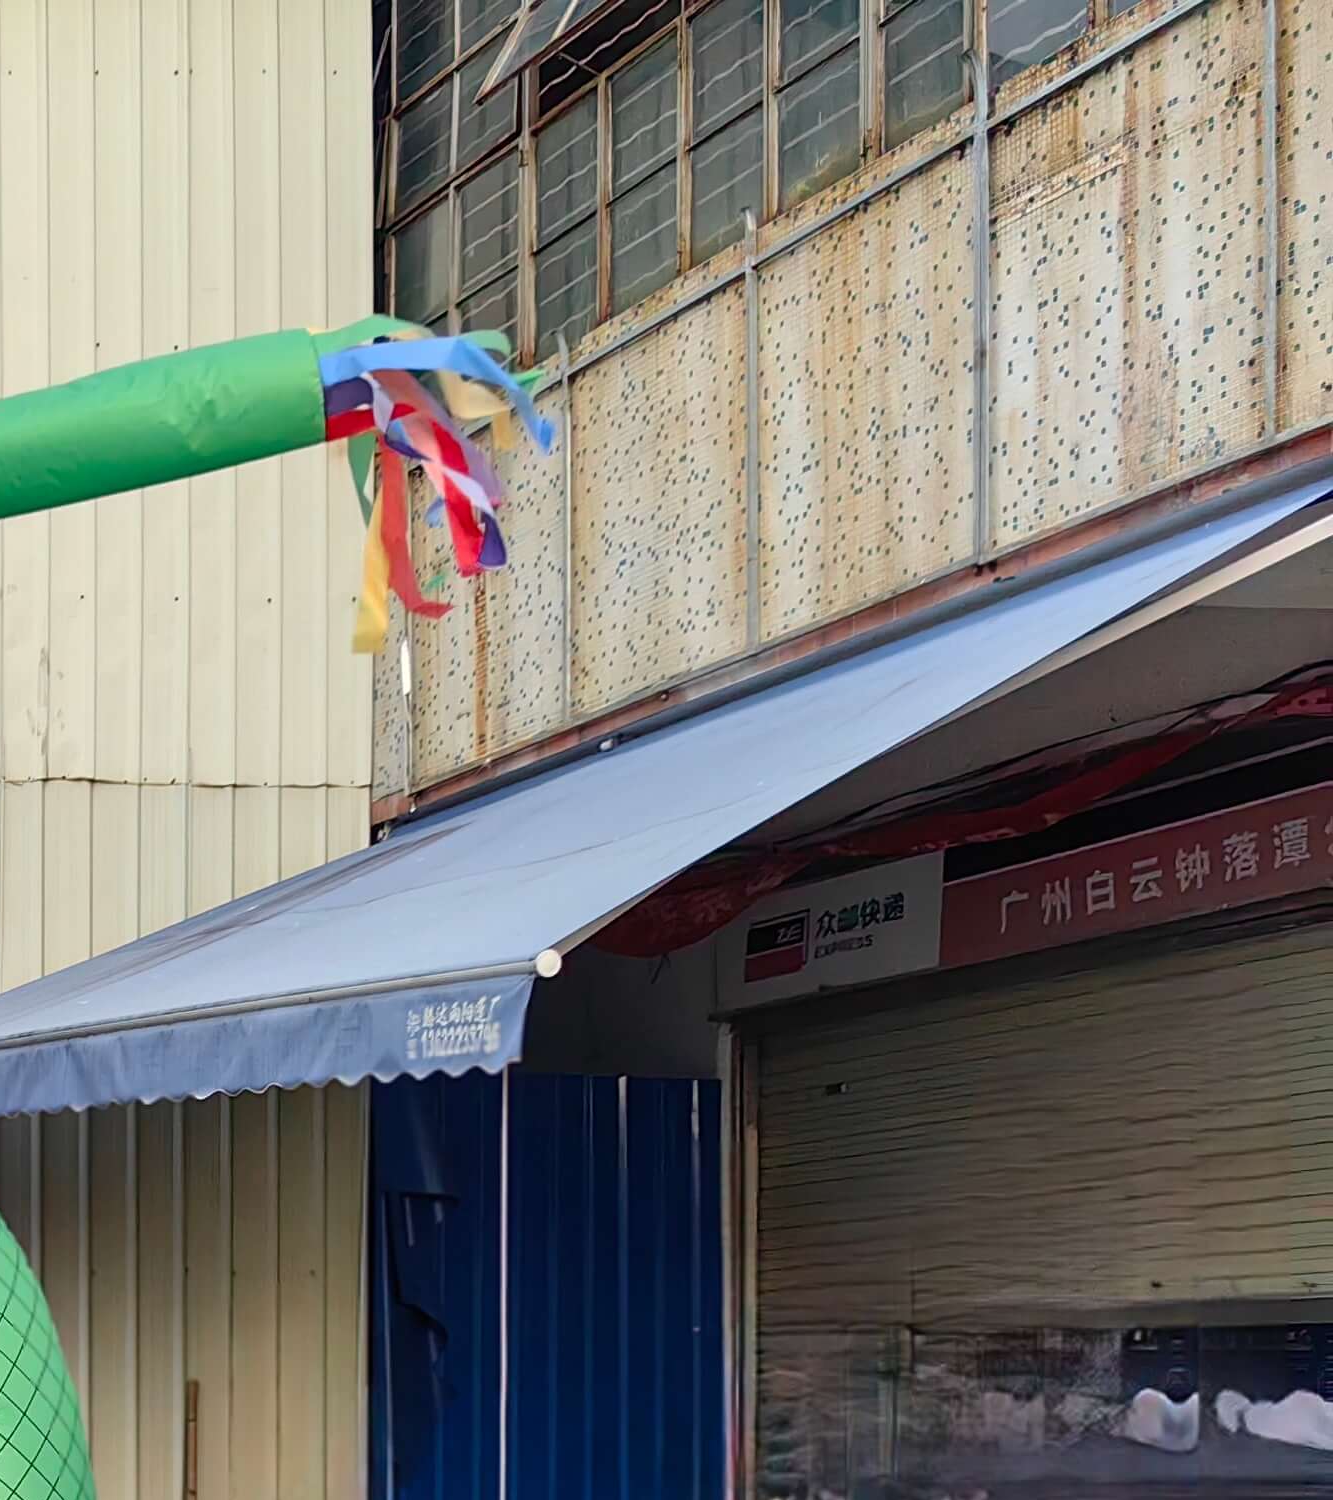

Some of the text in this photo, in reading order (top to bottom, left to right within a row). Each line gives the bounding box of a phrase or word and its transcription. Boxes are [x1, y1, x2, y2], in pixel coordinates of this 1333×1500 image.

[999, 815, 1333, 935] 广州白云钟落潭
